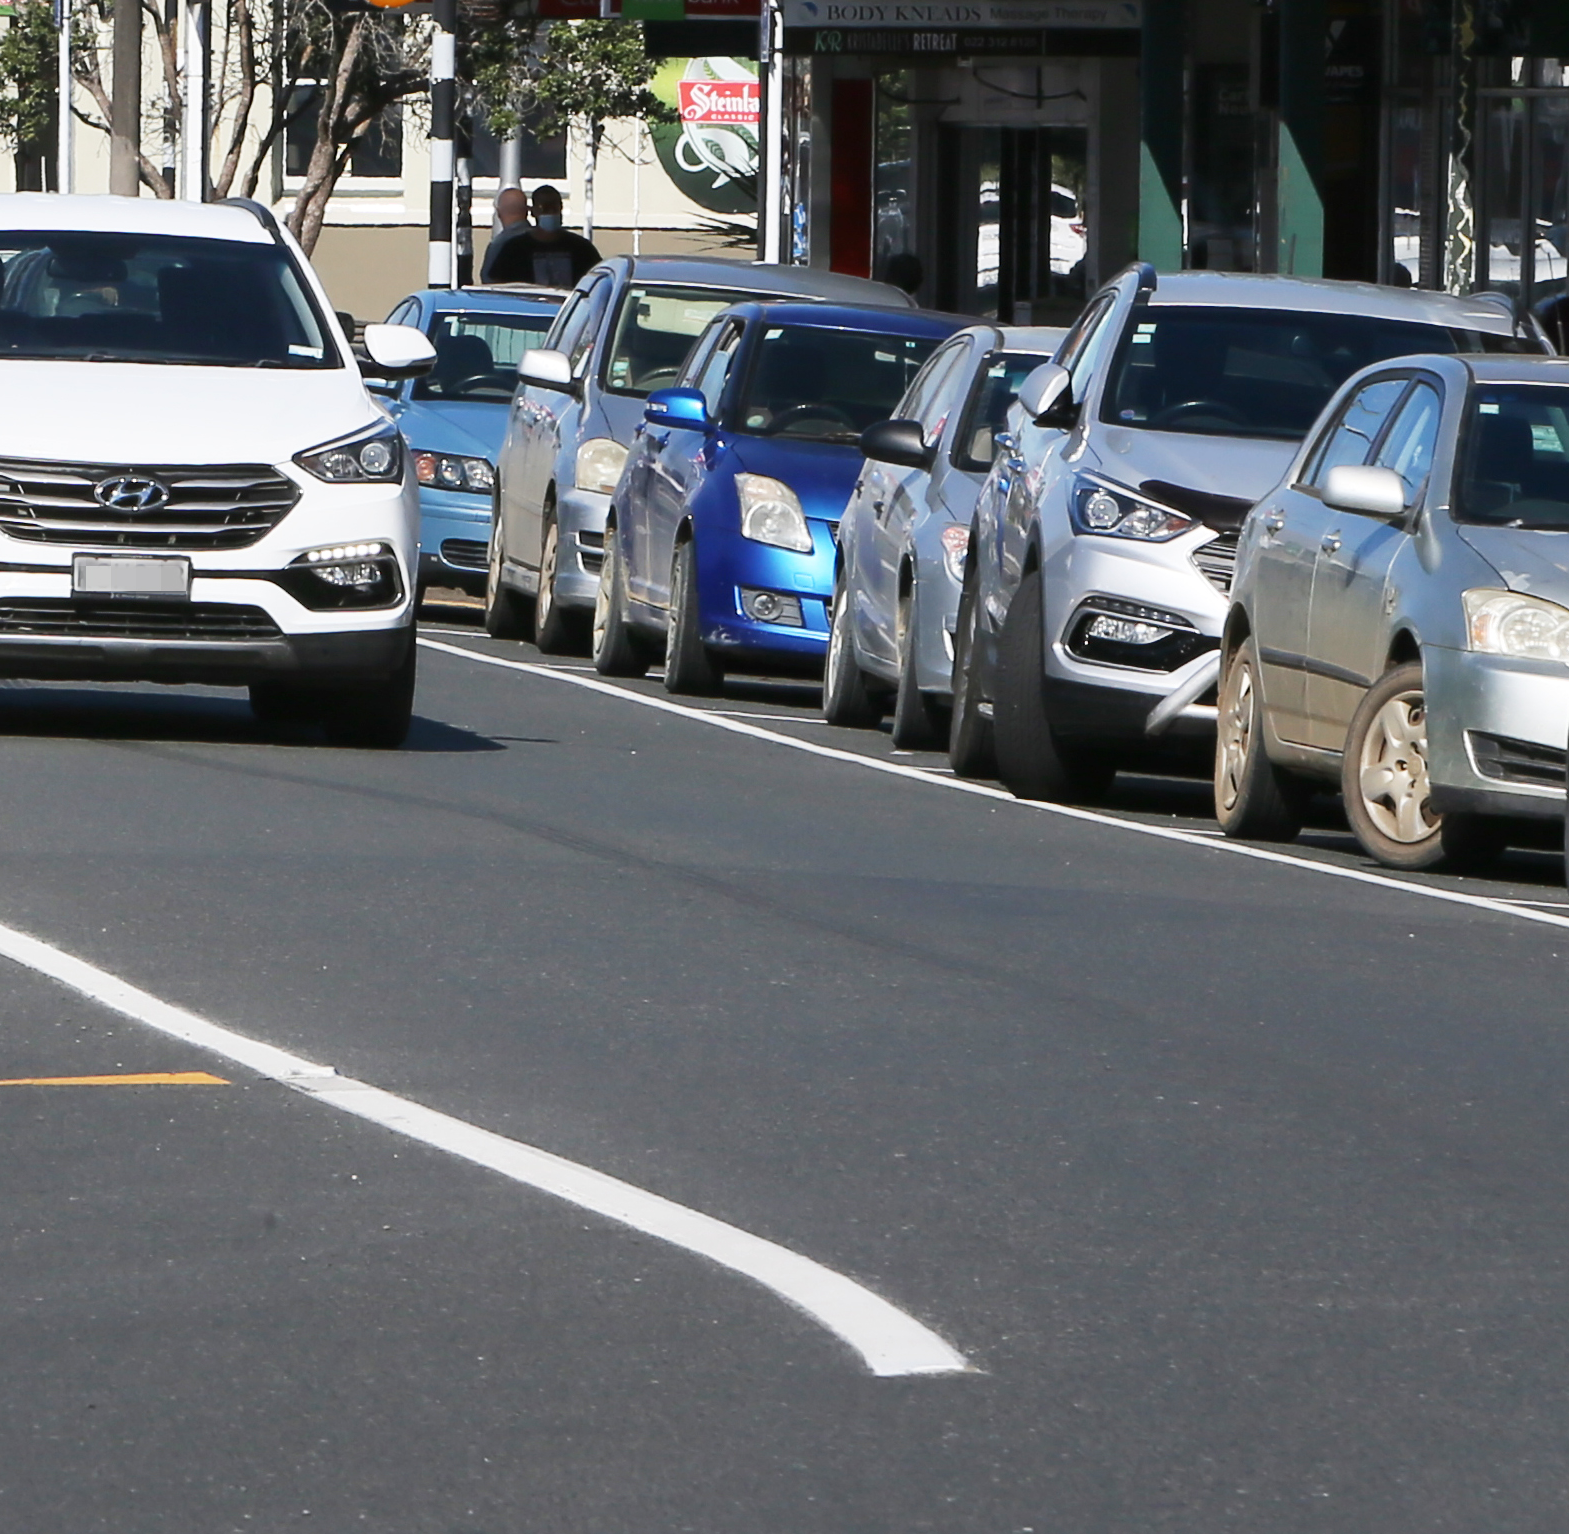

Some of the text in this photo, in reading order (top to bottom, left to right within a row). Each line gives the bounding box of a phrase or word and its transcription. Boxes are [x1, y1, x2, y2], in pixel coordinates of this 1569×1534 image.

[827, 4, 1108, 22] BODY KNEADS Massage Therapy
[913, 33, 958, 51] RETREAT
